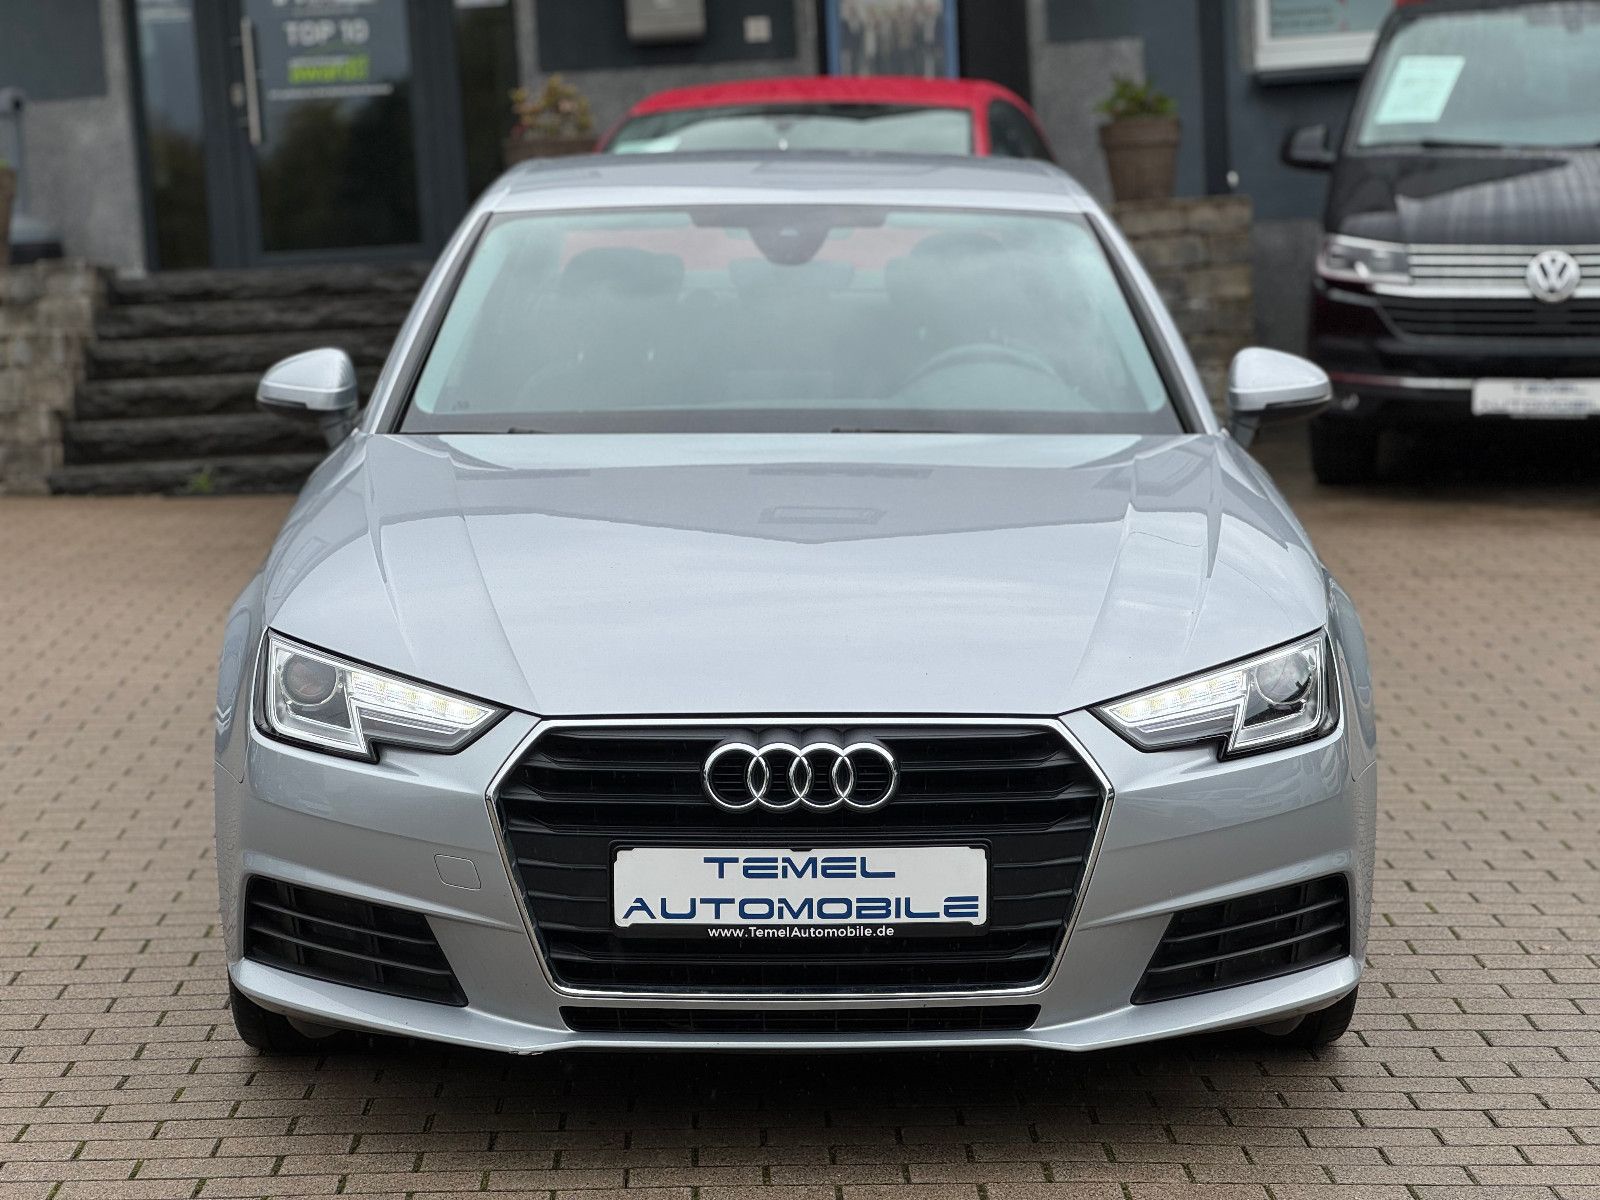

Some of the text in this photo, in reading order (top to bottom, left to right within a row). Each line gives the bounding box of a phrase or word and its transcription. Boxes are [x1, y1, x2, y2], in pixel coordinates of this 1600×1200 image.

[284, 18, 369, 47] TOP 10
[703, 857, 896, 879] TEMEL
[624, 896, 979, 920] AUTOMOBILE
[708, 926, 895, 940] www.TemelAutomobile.de
